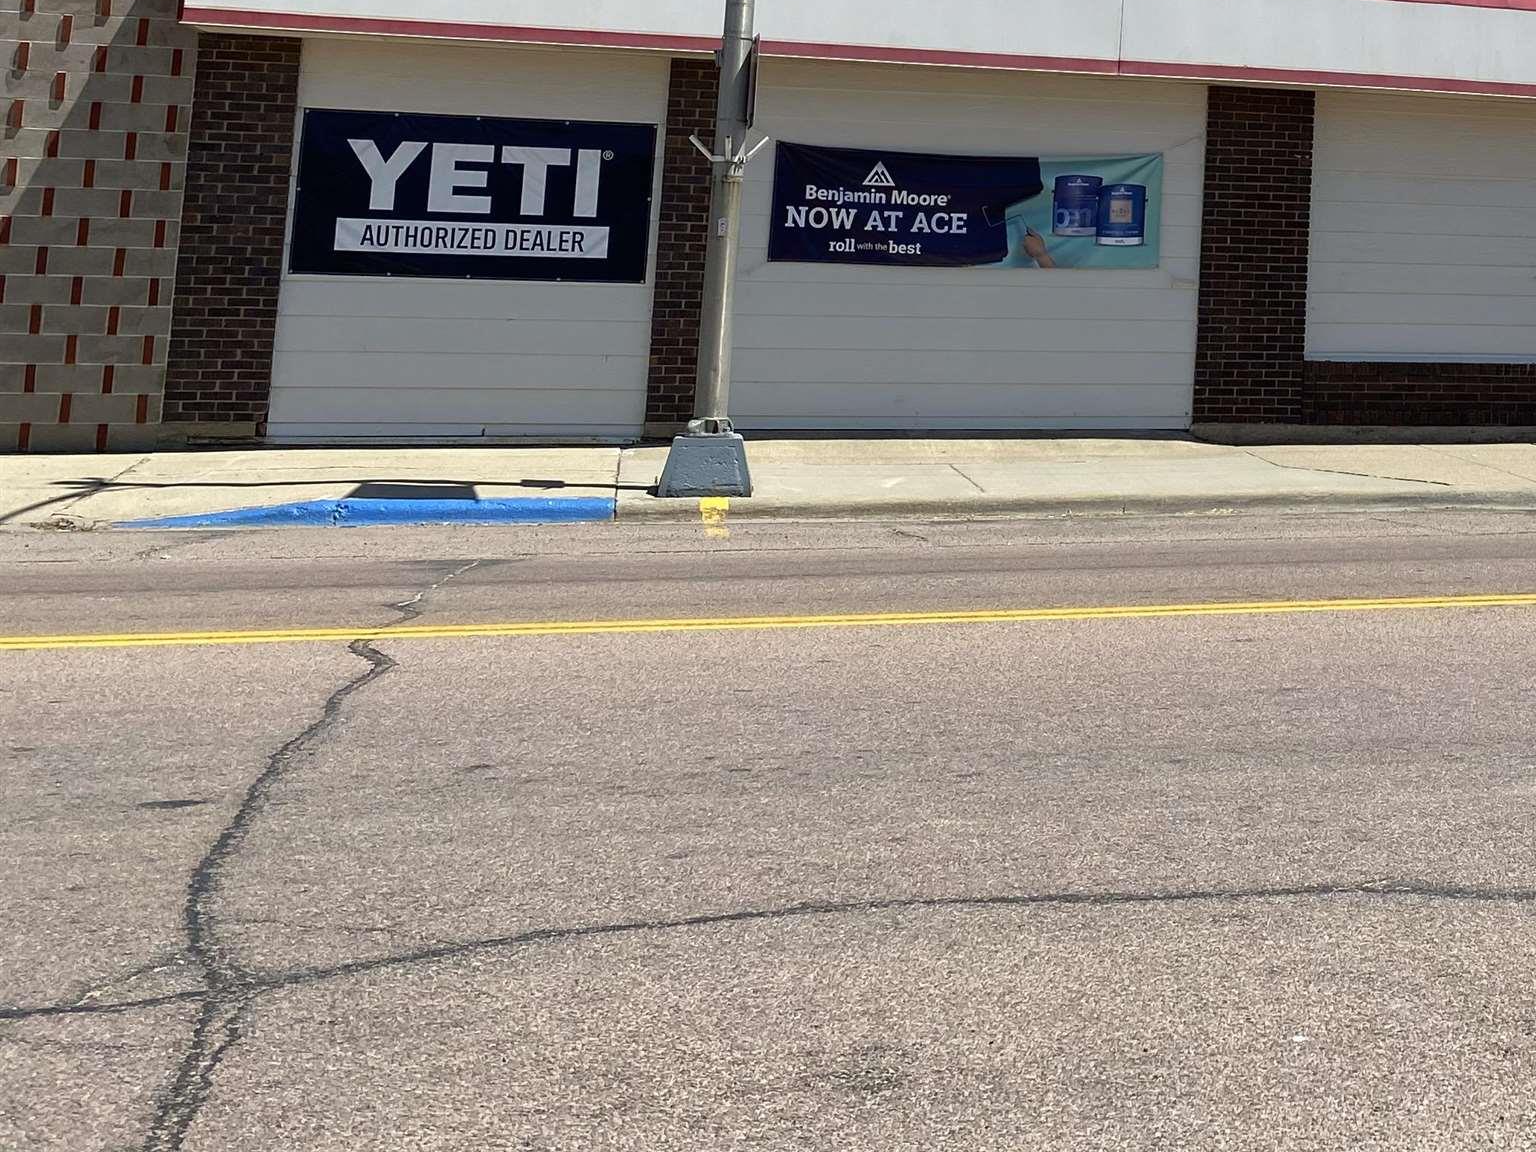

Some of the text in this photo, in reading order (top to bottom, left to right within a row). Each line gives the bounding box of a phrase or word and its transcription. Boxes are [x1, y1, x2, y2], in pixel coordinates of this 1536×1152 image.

[347, 138, 602, 217] YETI
[805, 184, 948, 206] Benjamin Moore
[784, 205, 967, 234] NOW AT ACE
[360, 224, 584, 252] AUTHORIZED DEALER
[828, 238, 921, 255] roll with the best
